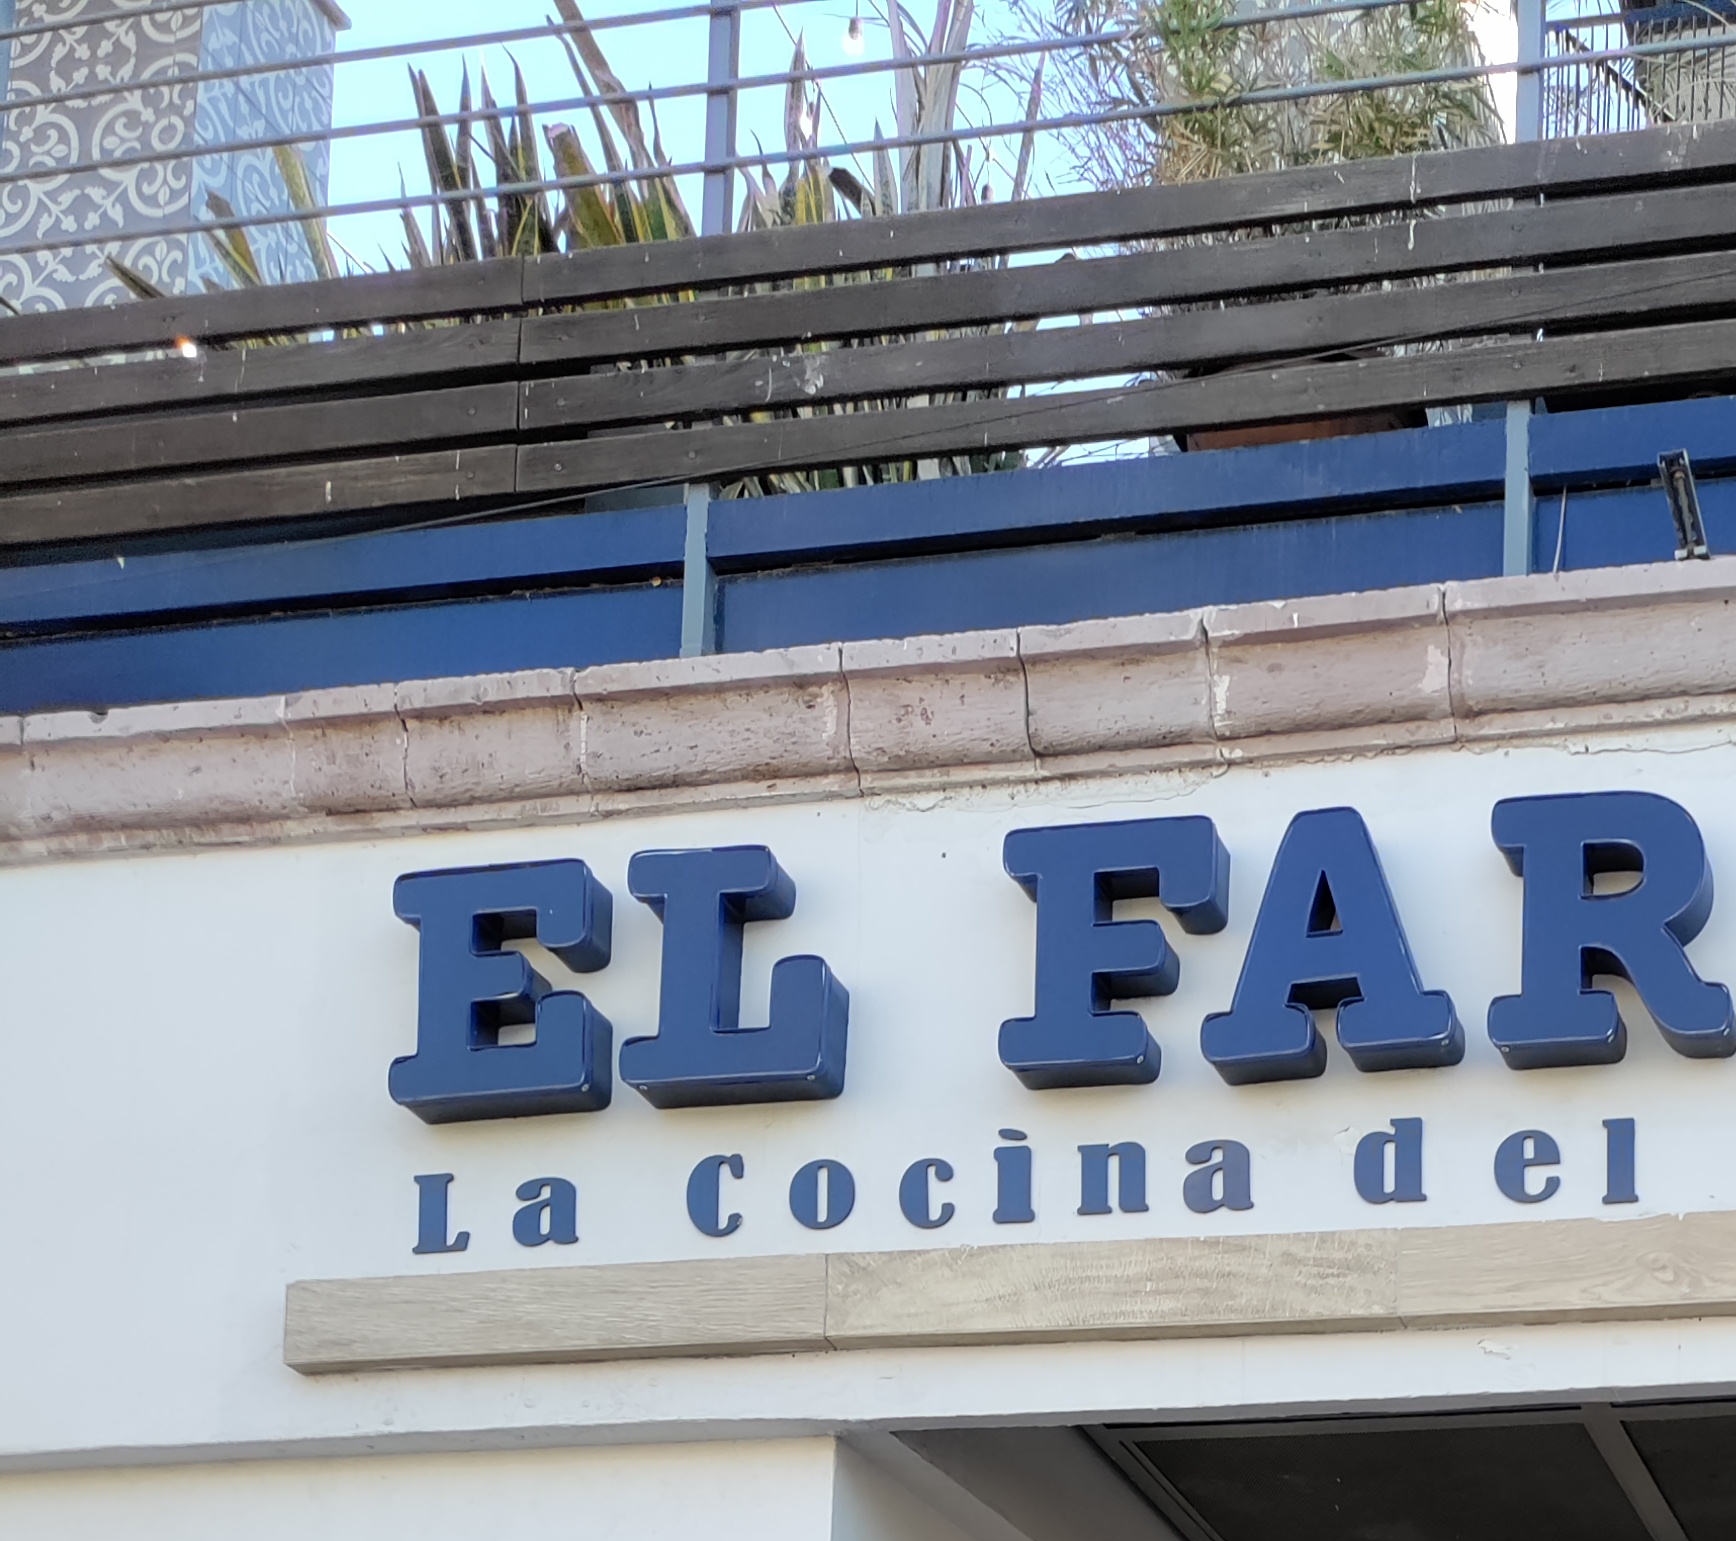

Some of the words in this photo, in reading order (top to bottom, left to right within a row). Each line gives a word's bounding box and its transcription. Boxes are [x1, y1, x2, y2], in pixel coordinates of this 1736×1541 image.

[387, 845, 850, 1126] EL
[413, 1171, 579, 1256] La
[686, 1128, 1255, 1238] Cocina
[1352, 1117, 1640, 1205] del
